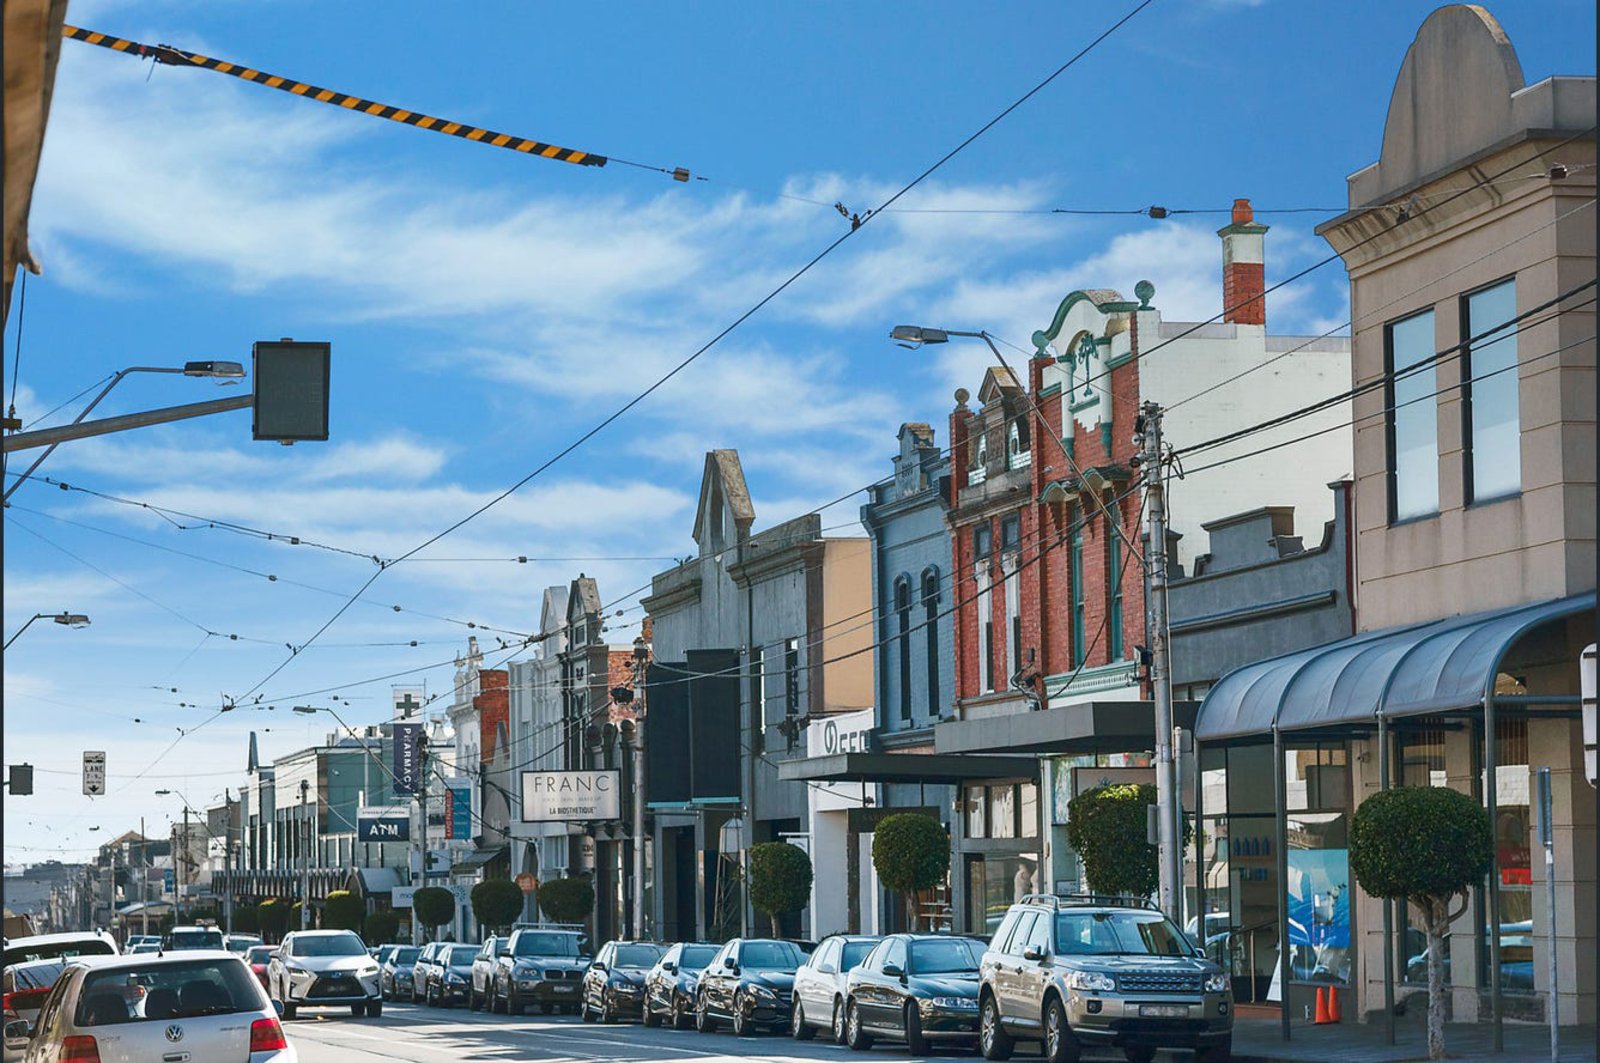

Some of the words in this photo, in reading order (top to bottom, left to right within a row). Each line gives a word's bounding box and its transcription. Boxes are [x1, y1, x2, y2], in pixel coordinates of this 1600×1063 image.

[403, 727, 412, 790] PHARMACY
[85, 765, 103, 773] LANE
[534, 775, 609, 792] FRANC
[549, 807, 556, 815] LA
[369, 824, 398, 836] ATM
